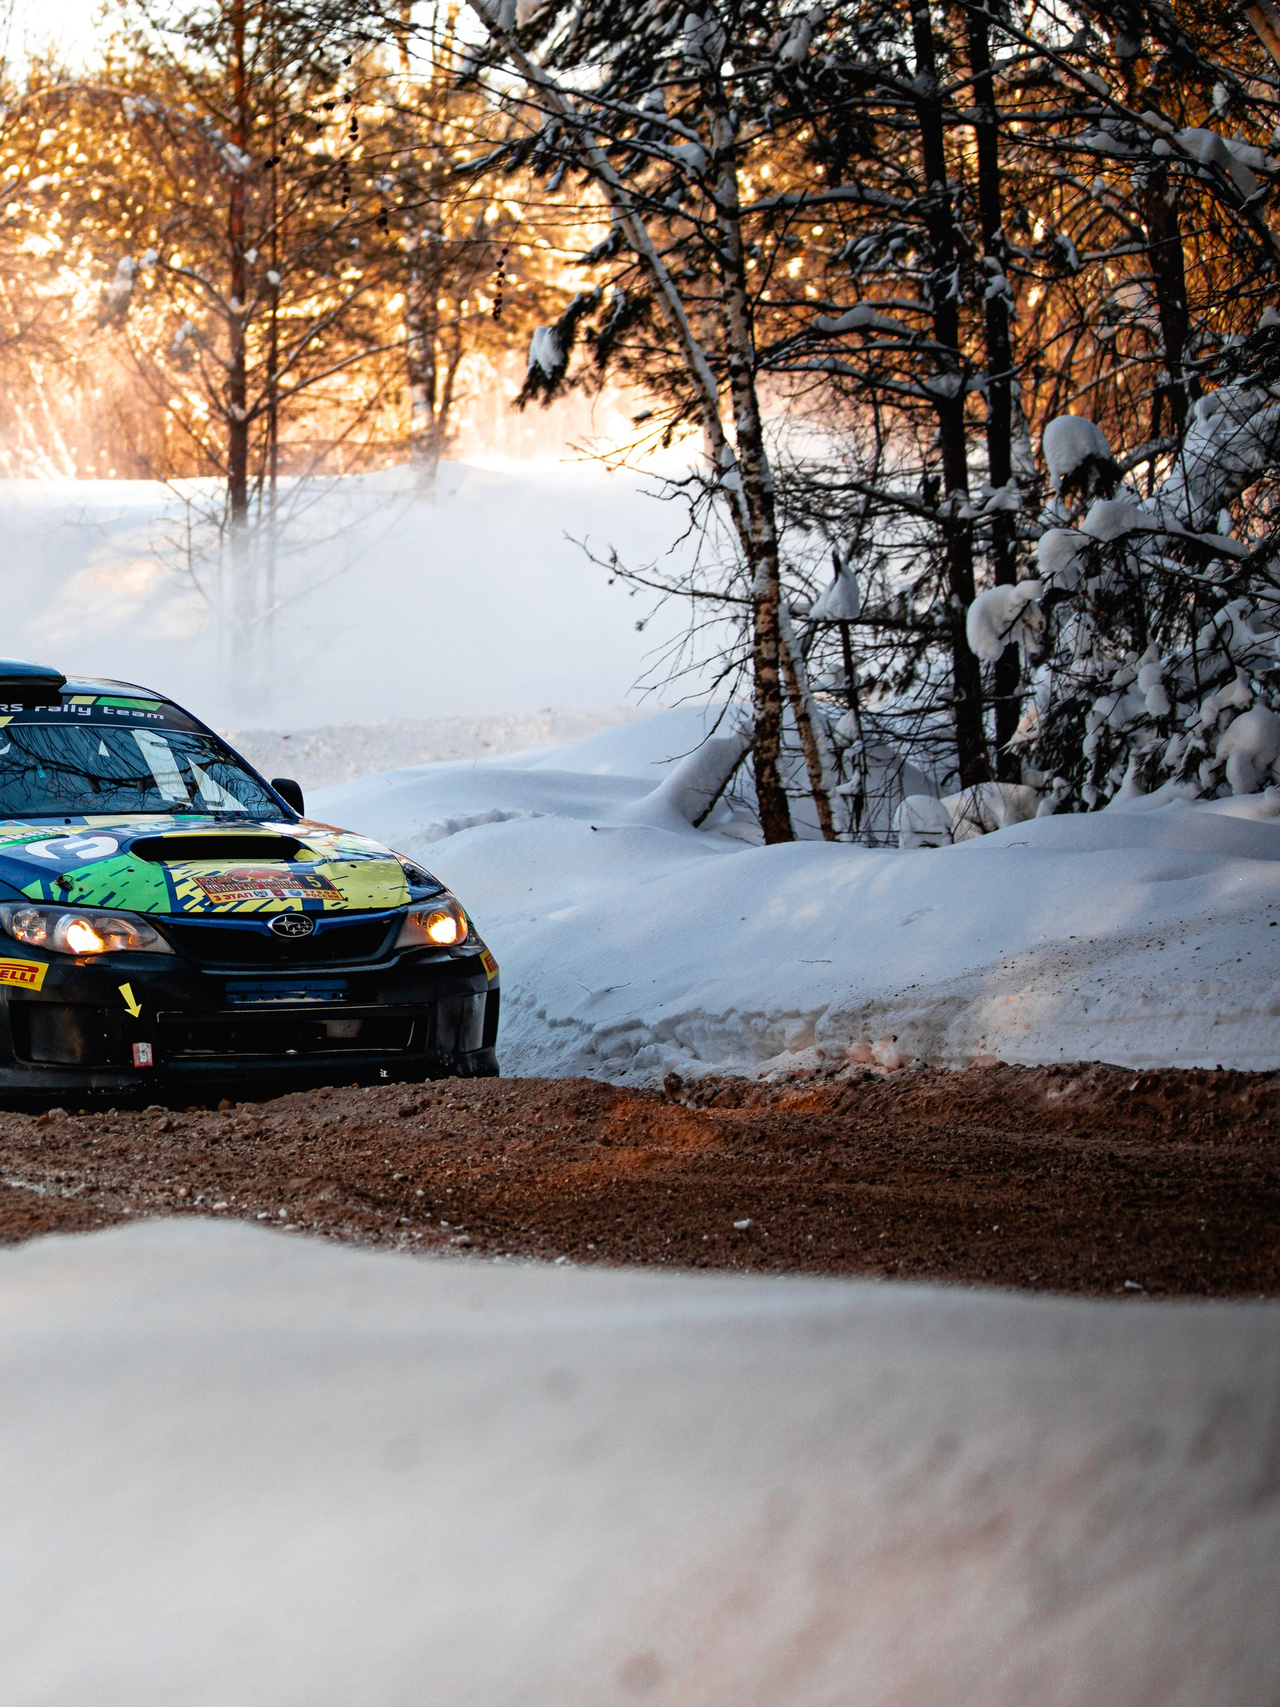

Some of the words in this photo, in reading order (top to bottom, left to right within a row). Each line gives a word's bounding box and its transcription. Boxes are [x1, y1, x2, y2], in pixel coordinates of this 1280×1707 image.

[35, 704, 91, 716] rally
[103, 706, 165, 720] team
[305, 876, 321, 888] 5
[224, 892, 254, 900] ЭТАП
